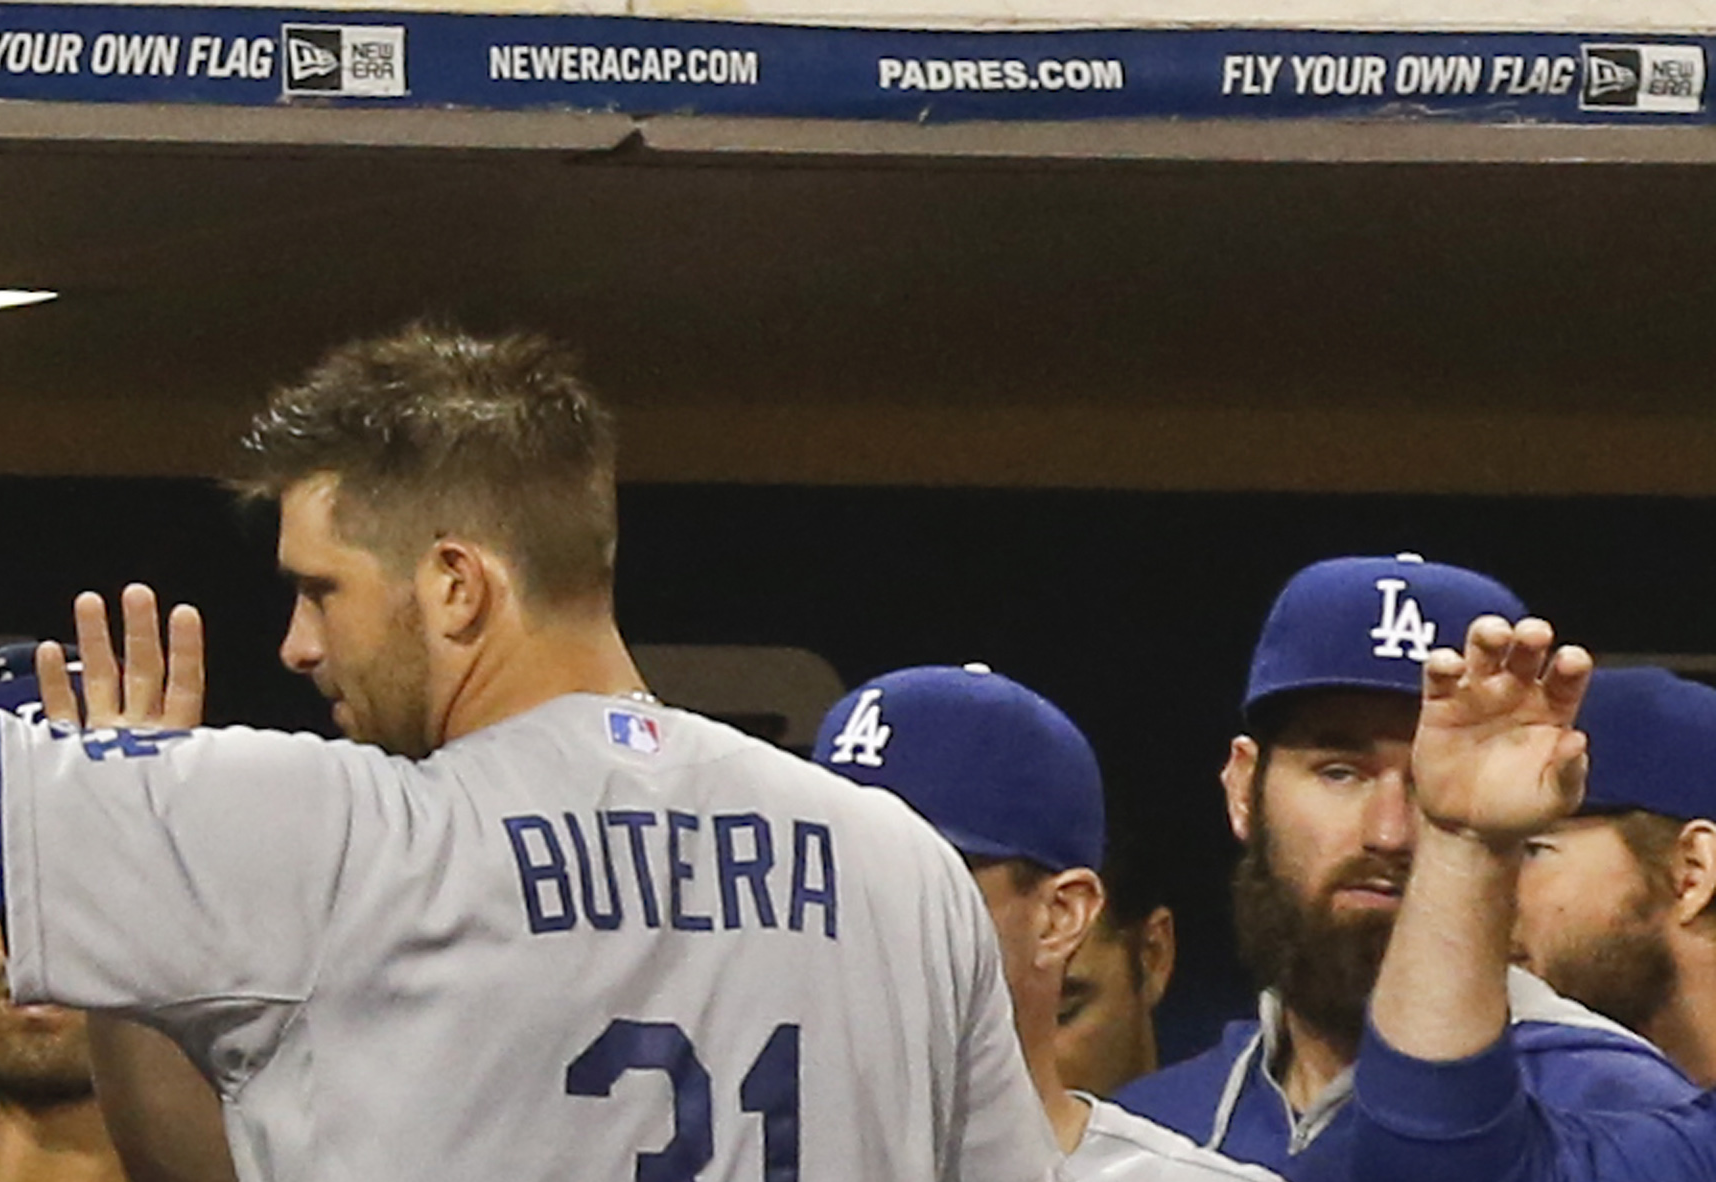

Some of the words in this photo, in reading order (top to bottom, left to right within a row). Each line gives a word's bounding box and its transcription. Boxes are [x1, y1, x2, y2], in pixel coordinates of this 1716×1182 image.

[91, 34, 180, 76] OWN
[187, 37, 274, 79] FLAG
[351, 42, 394, 60] NEW
[352, 60, 395, 79] ERA
[489, 45, 758, 85] NEWERACAP.COM
[879, 57, 1124, 90] PADRES.COM
[1222, 55, 1282, 95] FLY
[1291, 55, 1386, 95] YOUR
[1394, 56, 1483, 95] OWN
[1487, 55, 1577, 95] FLAG
[1370, 578, 1436, 661] LA
[830, 687, 891, 768] LA
[503, 808, 840, 940] BUTERA
